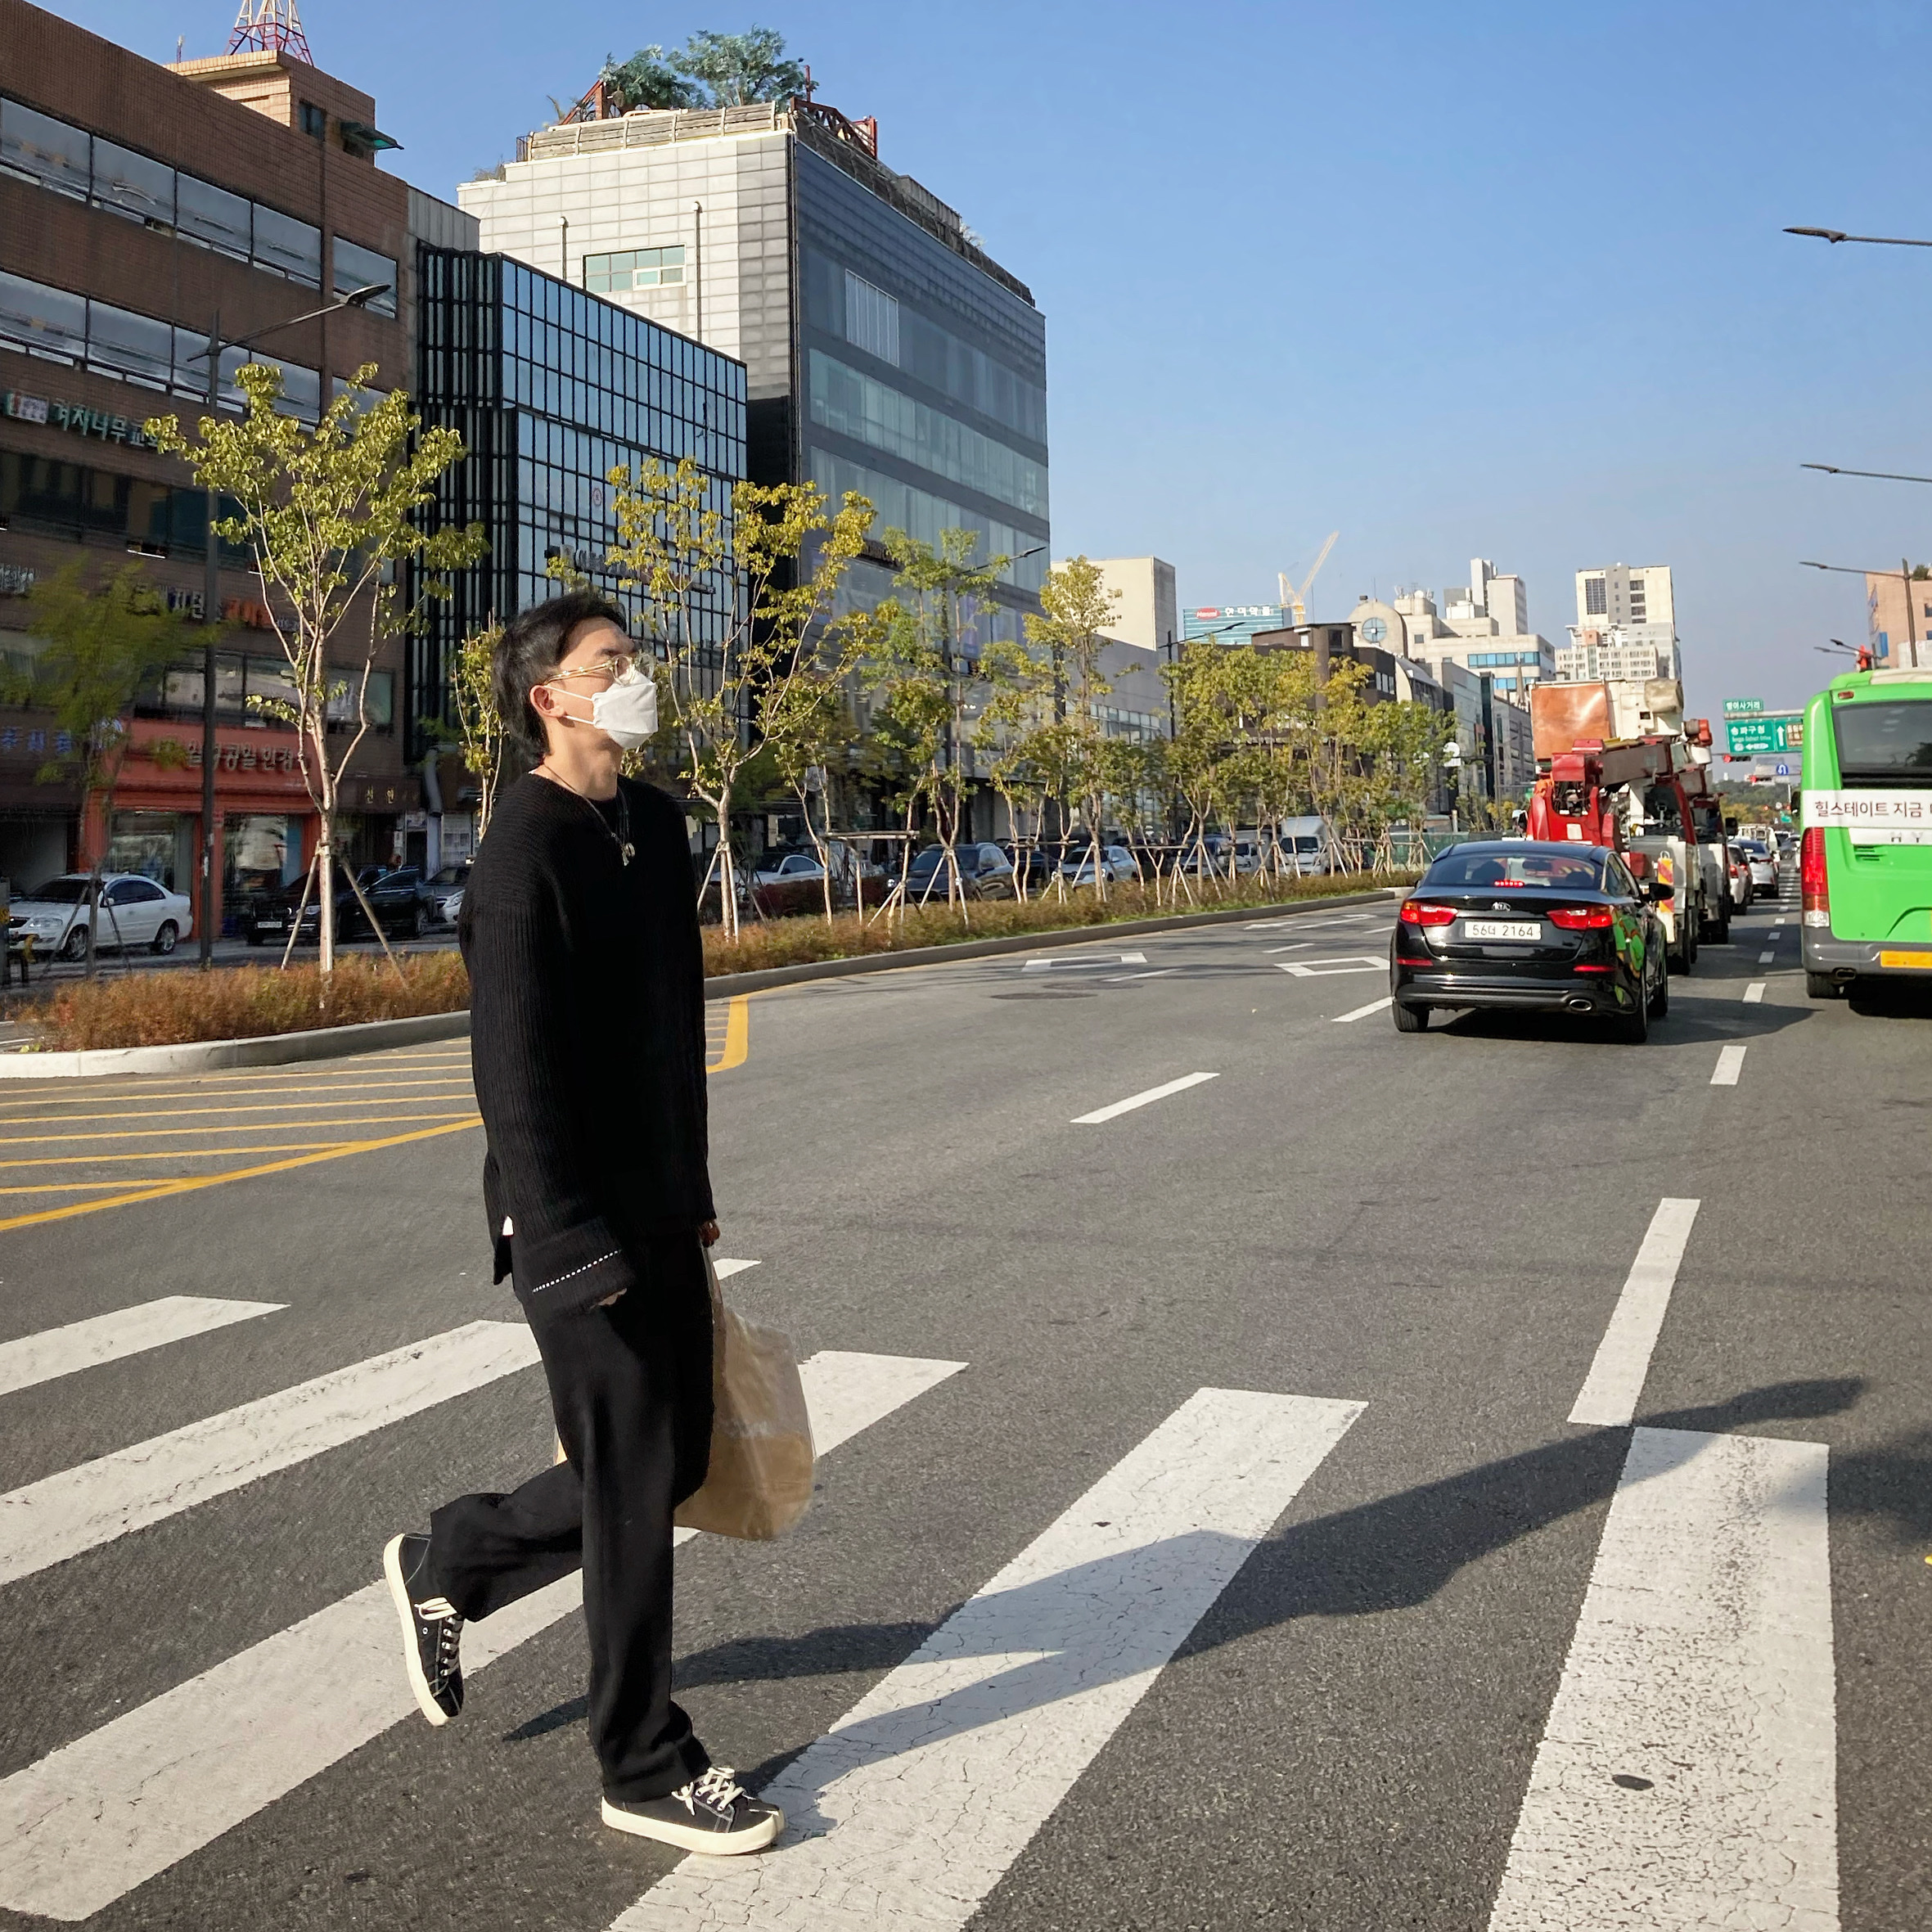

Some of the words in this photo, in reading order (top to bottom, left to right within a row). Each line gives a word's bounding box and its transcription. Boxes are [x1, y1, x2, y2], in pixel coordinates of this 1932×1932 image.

[1731, 725, 1765, 736] 송파구청
[1814, 800, 1889, 817] 힐스테이트
[1894, 800, 1924, 817] 지금
[1502, 925, 1533, 937] 2164
